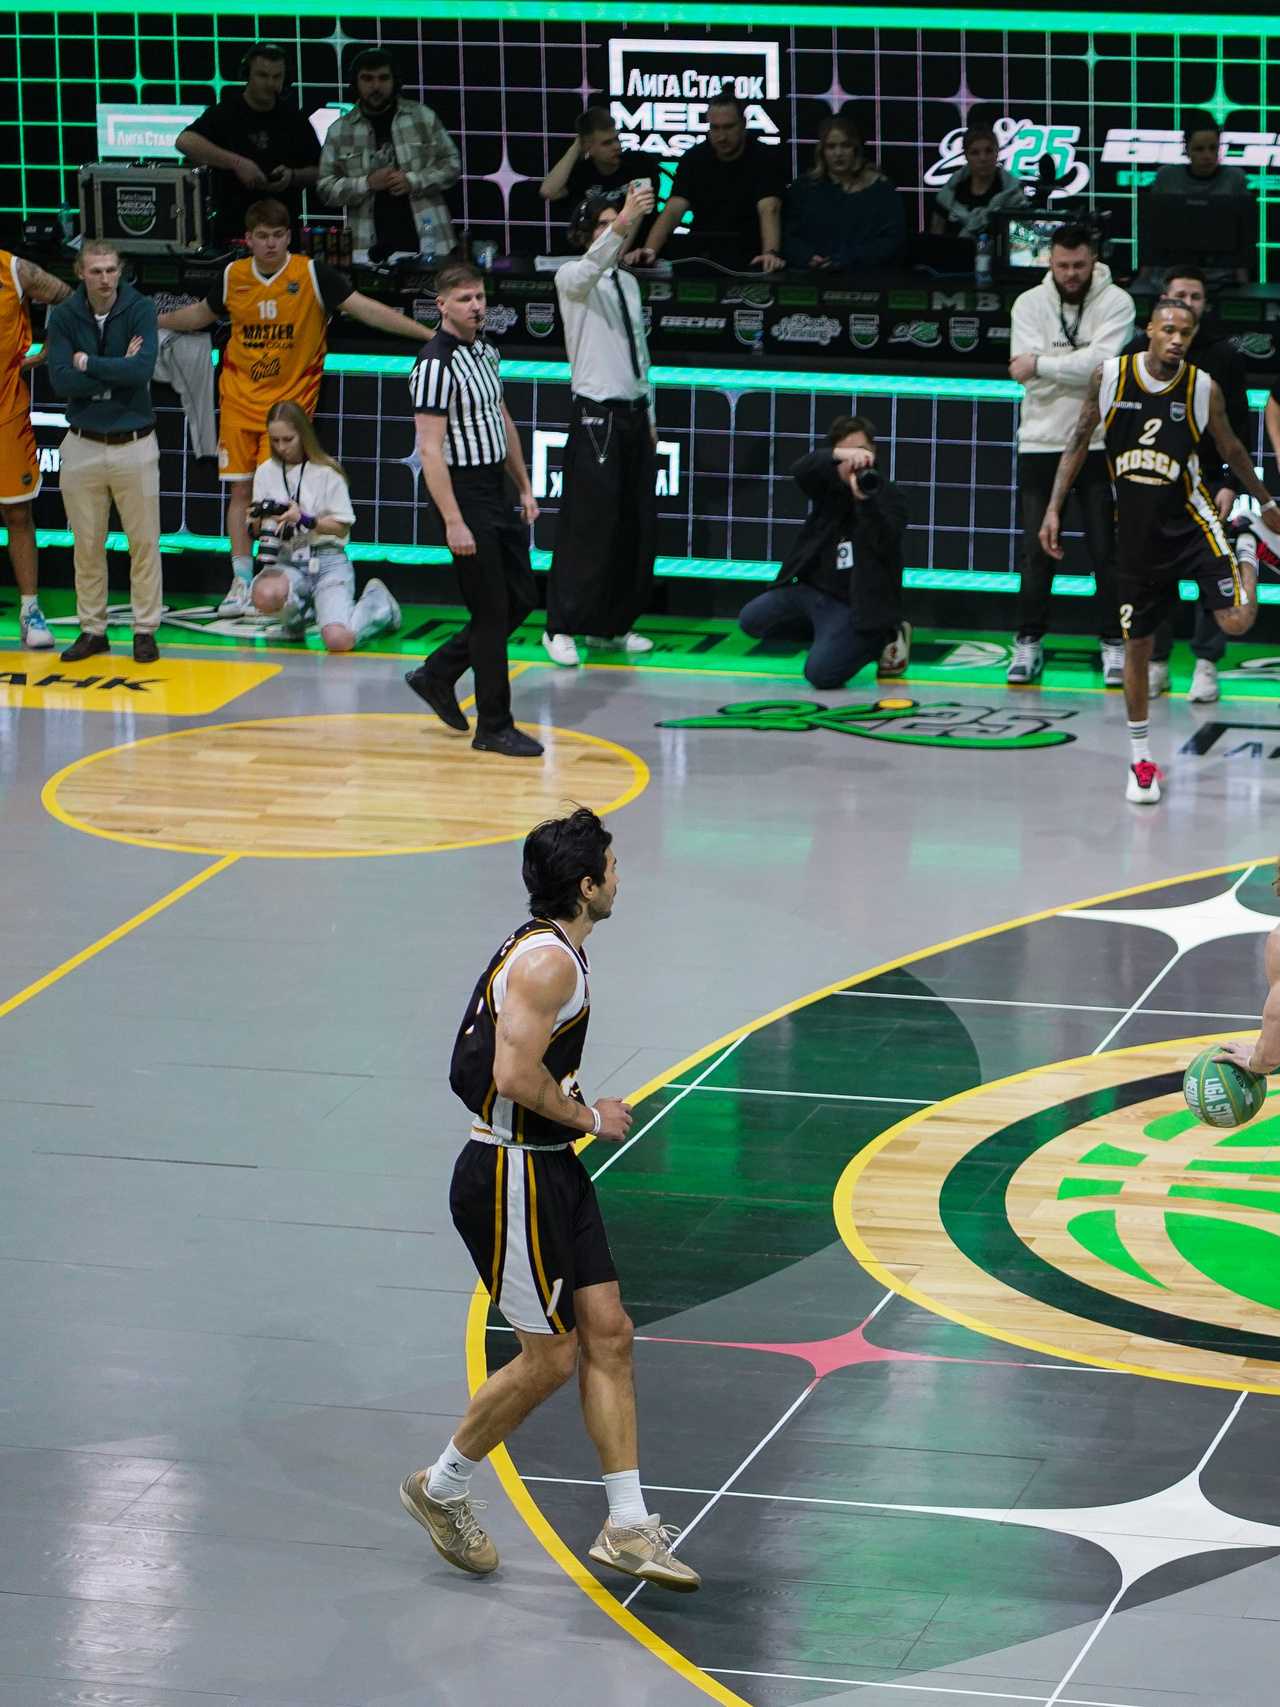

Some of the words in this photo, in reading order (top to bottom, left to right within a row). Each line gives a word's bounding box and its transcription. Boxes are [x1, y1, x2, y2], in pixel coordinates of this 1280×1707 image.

[609, 100, 780, 134] MEDA
[257, 299, 278, 320] 16
[242, 324, 294, 340] MASTER
[1137, 417, 1163, 446] 2
[1119, 603, 1134, 630] 2
[1204, 1077, 1227, 1103] LIGA
